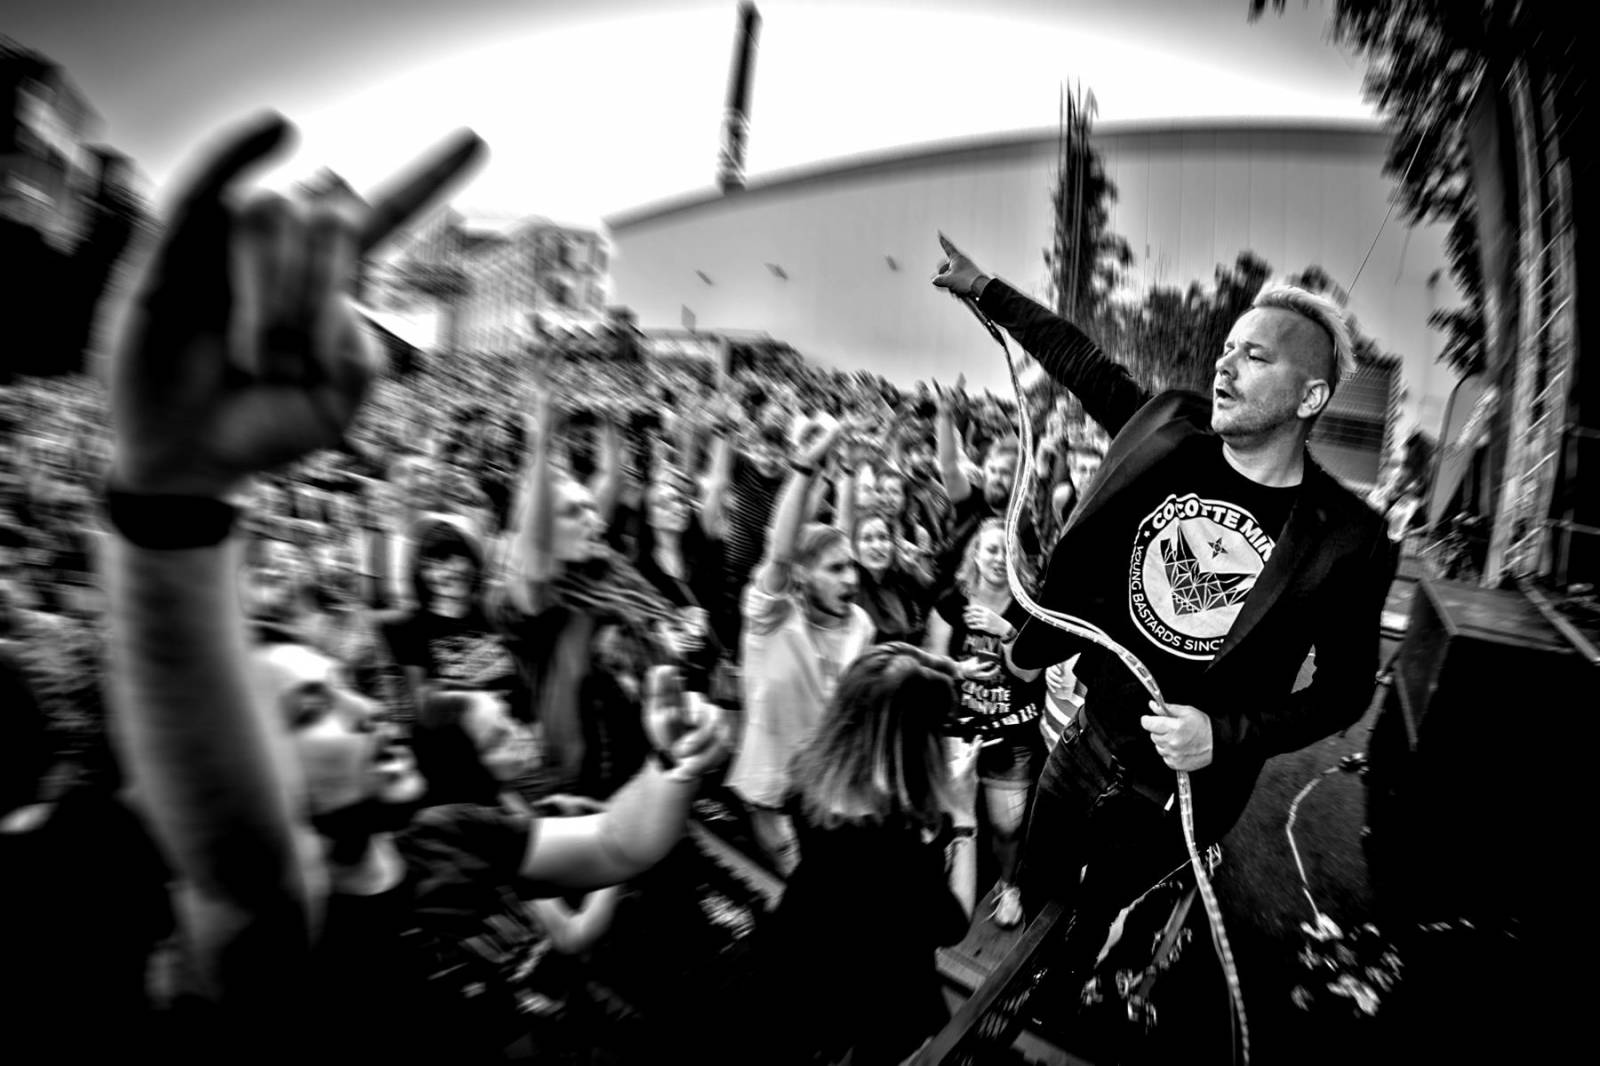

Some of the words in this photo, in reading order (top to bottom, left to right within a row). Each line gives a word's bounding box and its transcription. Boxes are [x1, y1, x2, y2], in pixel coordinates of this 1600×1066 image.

[1131, 545, 1144, 591] YOUNG
[1132, 593, 1182, 648] BASTARDS
[1183, 639, 1225, 652] SINC
